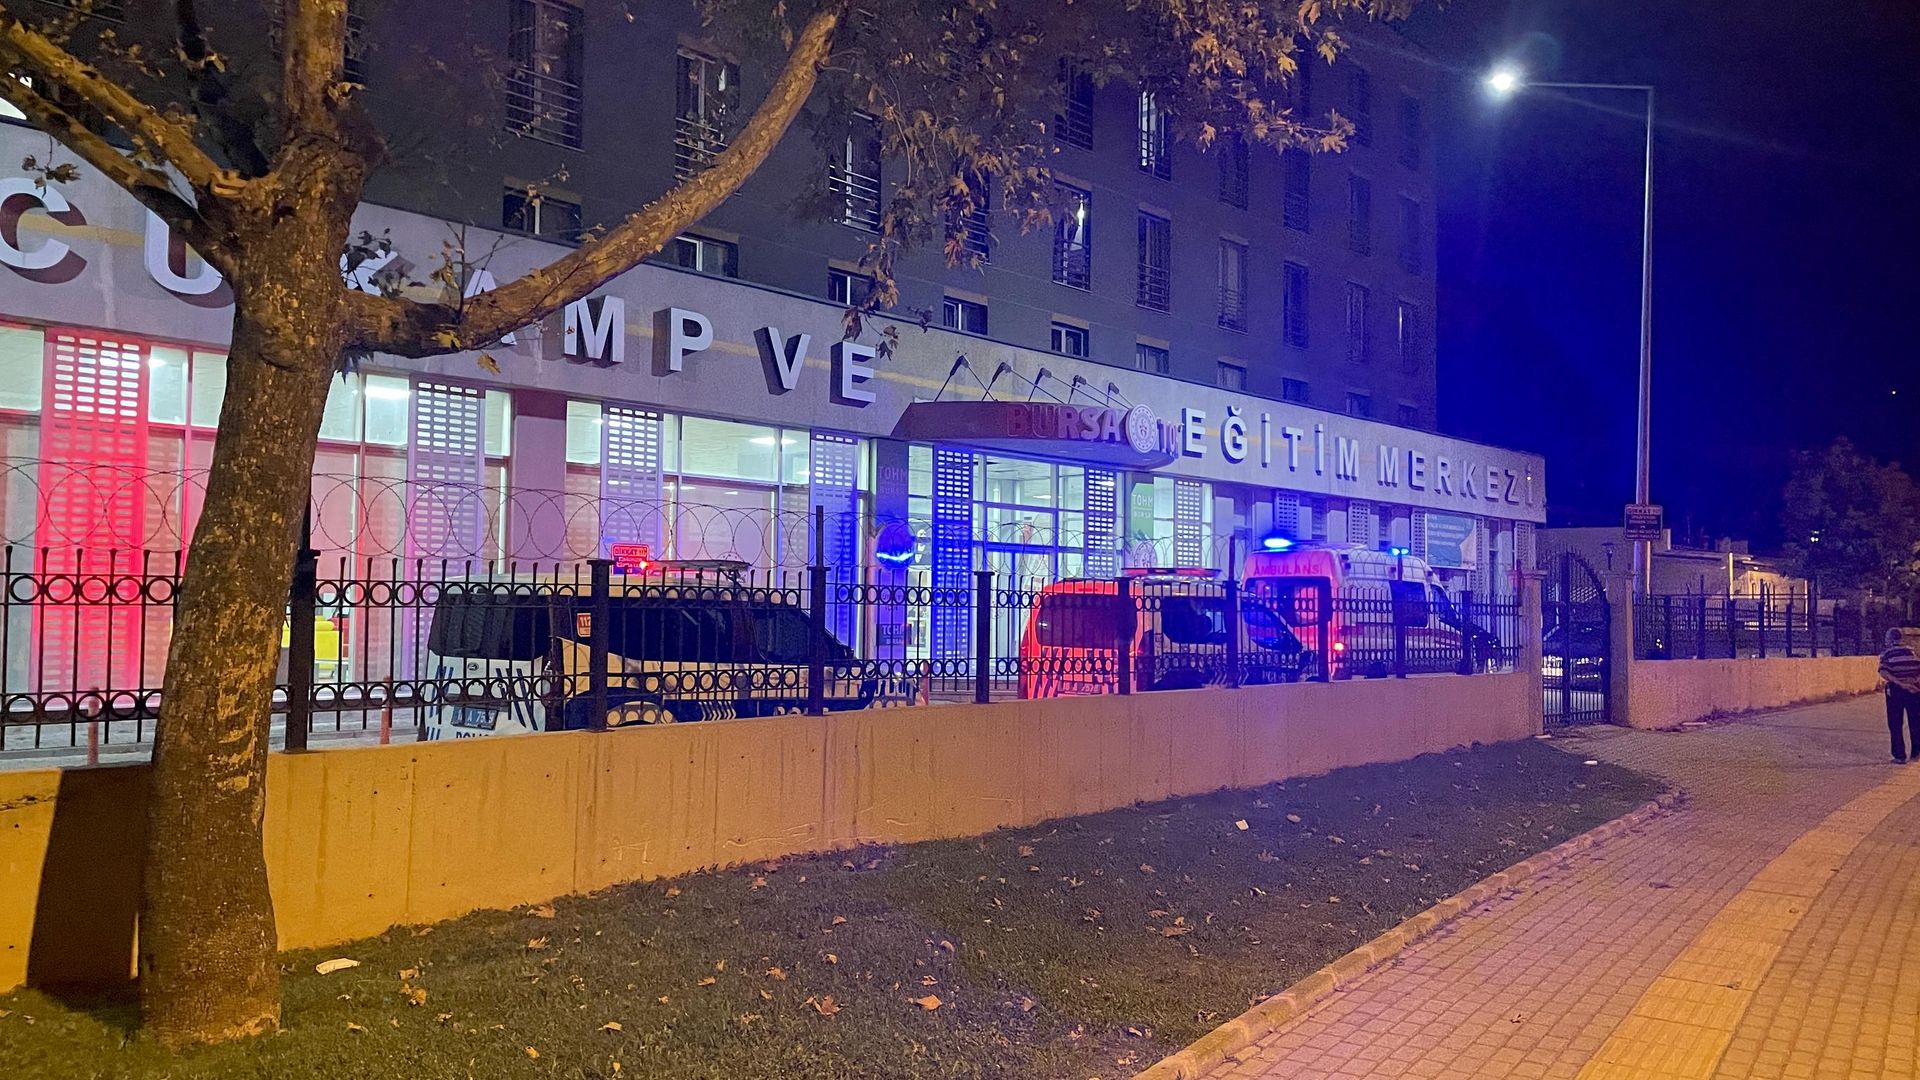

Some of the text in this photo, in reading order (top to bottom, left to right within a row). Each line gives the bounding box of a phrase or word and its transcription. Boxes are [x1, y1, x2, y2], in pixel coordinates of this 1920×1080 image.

[758, 326, 878, 405] VE
[1183, 405, 1360, 480] EĞİTİM
[1378, 445, 1533, 504] MERKEZİ
[1006, 403, 1121, 442] BURSA
